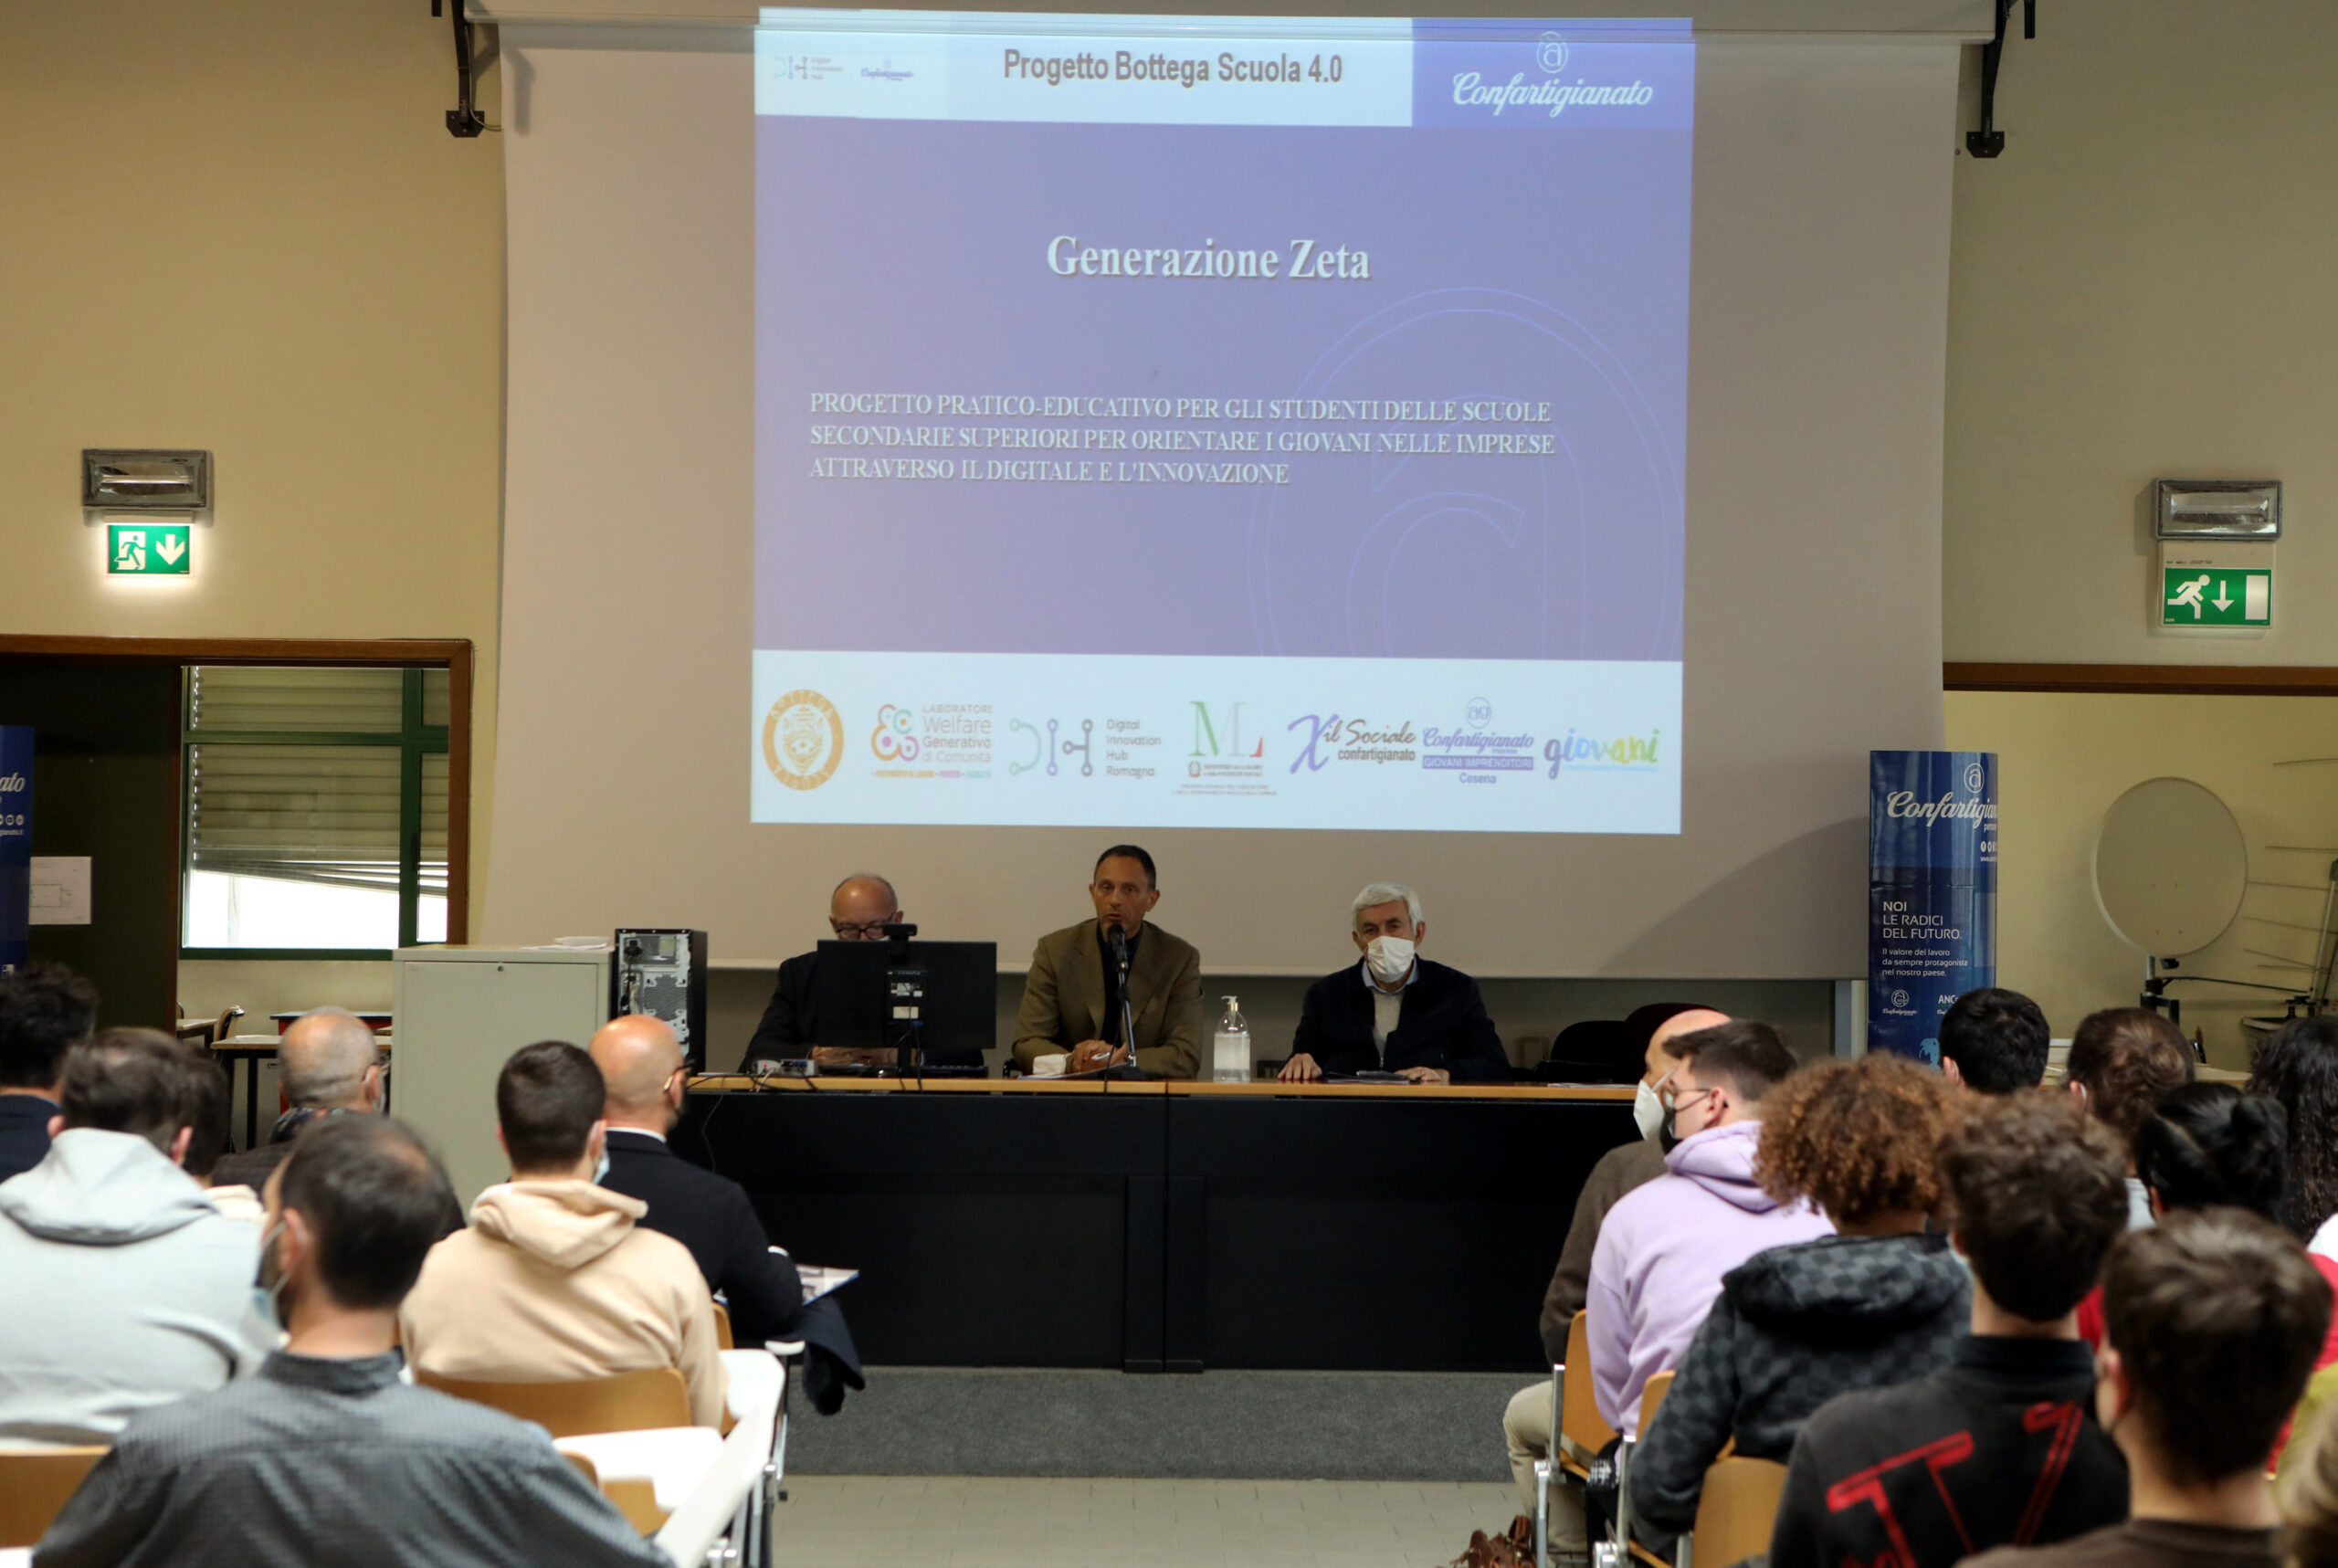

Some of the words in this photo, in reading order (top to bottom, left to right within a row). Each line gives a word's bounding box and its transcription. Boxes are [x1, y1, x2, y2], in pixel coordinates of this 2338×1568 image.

[1004, 48, 1109, 86] Progetto
[1115, 50, 1209, 89] Bottega
[1217, 52, 1301, 82] Scuola
[1308, 54, 1343, 82] 4.0
[1453, 72, 1653, 118] Confartigianato
[1047, 235, 1279, 278] Generazione
[1288, 238, 1371, 279] Zeta
[809, 392, 932, 415] PROGETTO
[937, 395, 1171, 417] PRATICO-EDUCATIVO
[1175, 398, 1220, 419] PER
[1225, 399, 1264, 419] GLI
[1269, 399, 1379, 420] STUDENTI
[1384, 401, 1458, 421] DELLE
[1461, 401, 1552, 422] SCUOLE
[809, 425, 954, 447] SECONDARIE
[959, 427, 1078, 449] SUPERIORI
[1084, 429, 1128, 449] PER
[1131, 429, 1260, 451] ORIENTARE
[1265, 432, 1274, 451] I
[1279, 432, 1372, 453] GIOVANI
[1378, 434, 1450, 454] NELLE
[1456, 434, 1555, 455] IMPRESE
[809, 458, 955, 479] ATTRAVERSO
[961, 459, 983, 480] IL
[987, 460, 1093, 481] DIGITALE
[1099, 462, 1112, 482] E
[1118, 462, 1290, 484] L'INNOVAZIONE
[922, 704, 992, 713] LABORATORI
[922, 715, 992, 734] Welfare
[1106, 719, 1141, 731] Digital
[1345, 719, 1416, 746] Sociale
[922, 735, 992, 749] Generativo
[1106, 735, 1162, 746] Innovation
[1422, 727, 1534, 754] Confartigianato
[922, 751, 933, 763] di
[1106, 750, 1129, 761] Hub
[1338, 747, 1416, 764] confartigianato
[1543, 727, 1660, 780] giovani
[1426, 757, 1464, 768] GIOVANI
[1466, 758, 1532, 769] IMPRENDITORI
[1106, 765, 1155, 779] Romagna
[1459, 773, 1497, 784] Cesena
[1883, 901, 1907, 911] NOI
[1883, 914, 1898, 925] LE
[1901, 915, 1943, 926] RADICI
[1882, 928, 1907, 939] DEL
[1911, 929, 1962, 940] FUTURO.
[1882, 948, 1888, 956] Il
[1894, 960, 1923, 968] sempre
[1924, 959, 1968, 968] protagonista
[1922, 970, 1947, 978] paese.
